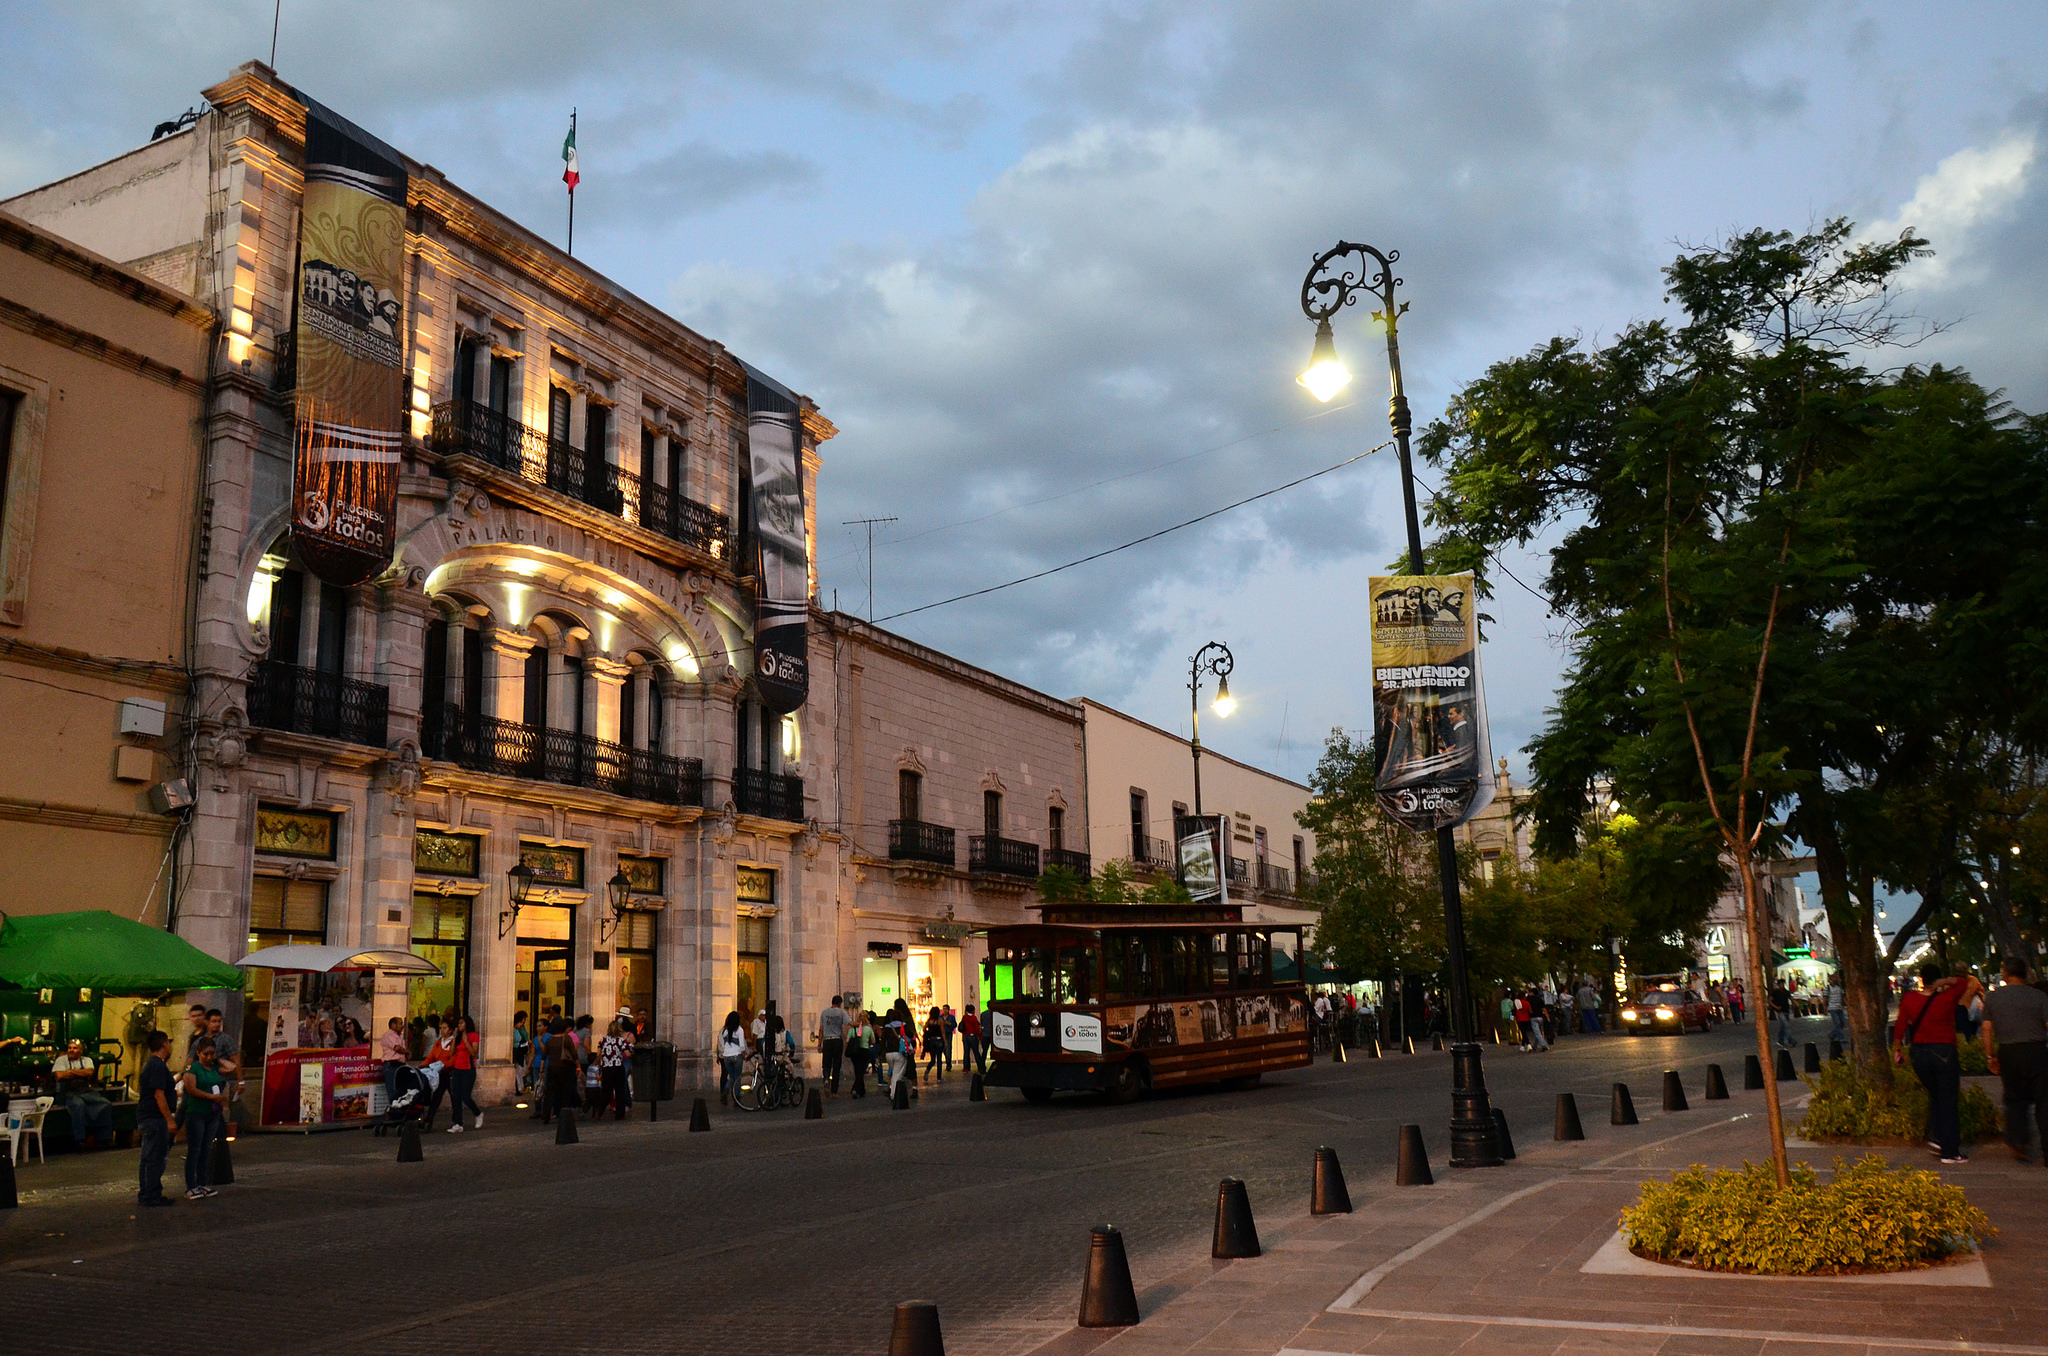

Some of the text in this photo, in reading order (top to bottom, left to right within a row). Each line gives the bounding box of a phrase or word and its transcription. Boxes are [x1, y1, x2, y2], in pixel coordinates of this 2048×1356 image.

[336, 499, 385, 523] PROGRESO
[342, 512, 361, 524] para
[335, 516, 384, 547] todos
[452, 527, 554, 547] PALACIO
[596, 550, 720, 659] LEGISLATIVO
[779, 664, 804, 683] todos
[1376, 665, 1470, 681] BIENVENIDO
[1401, 678, 1466, 688] PRESIDENTE
[1421, 787, 1459, 795] PROGRESO
[1422, 797, 1460, 810] todos
[334, 1064, 369, 1073] Información
